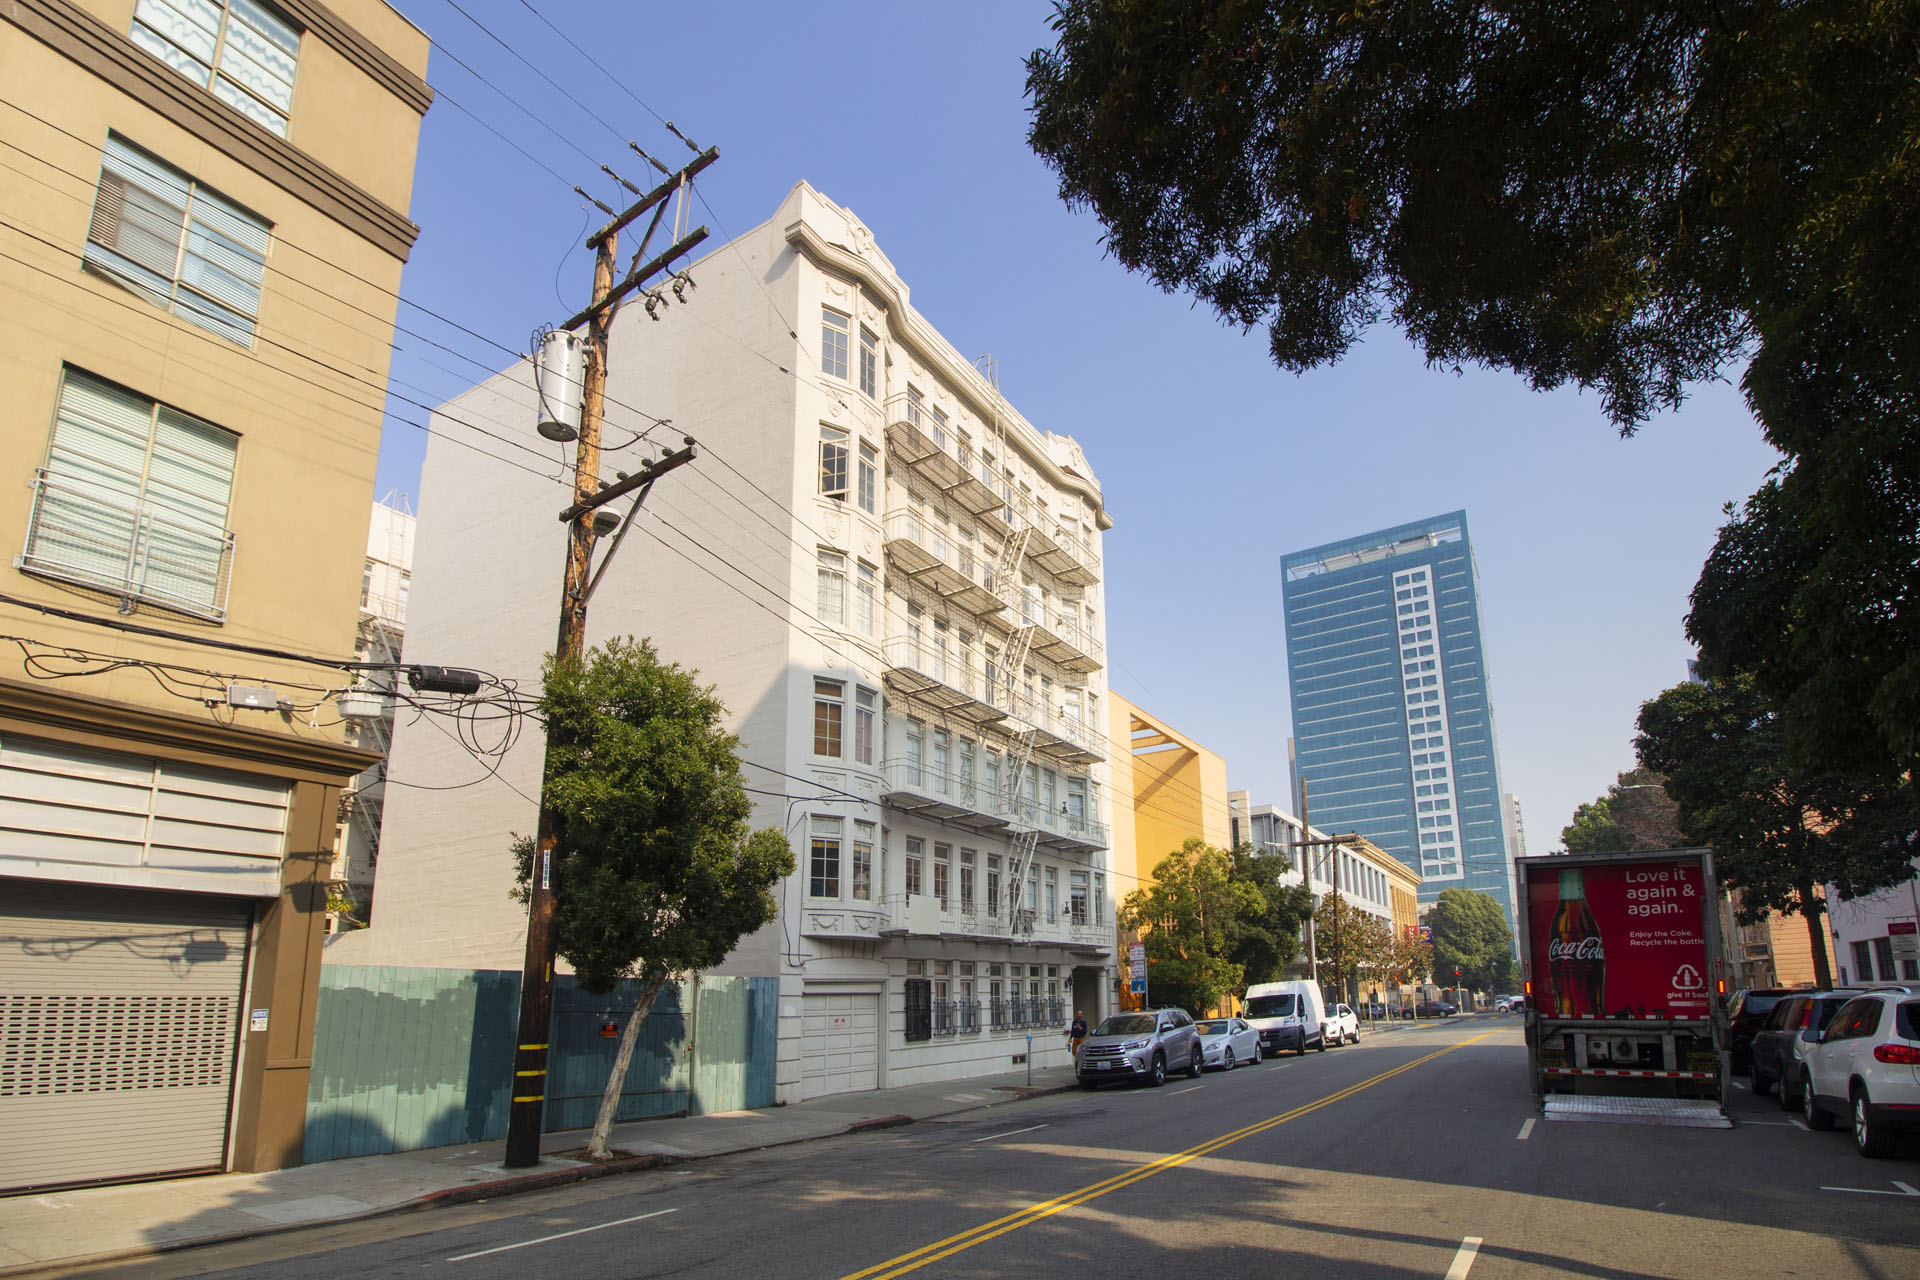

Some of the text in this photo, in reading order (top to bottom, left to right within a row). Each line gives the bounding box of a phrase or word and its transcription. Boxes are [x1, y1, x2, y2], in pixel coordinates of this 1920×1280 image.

[1626, 868, 1686, 883] Love it
[1626, 884, 1695, 900] again &
[1628, 901, 1684, 917] again.
[1549, 936, 1604, 962] Coca-Cola
[1630, 939, 1662, 947] Recycle
[1667, 991, 1683, 999] give
